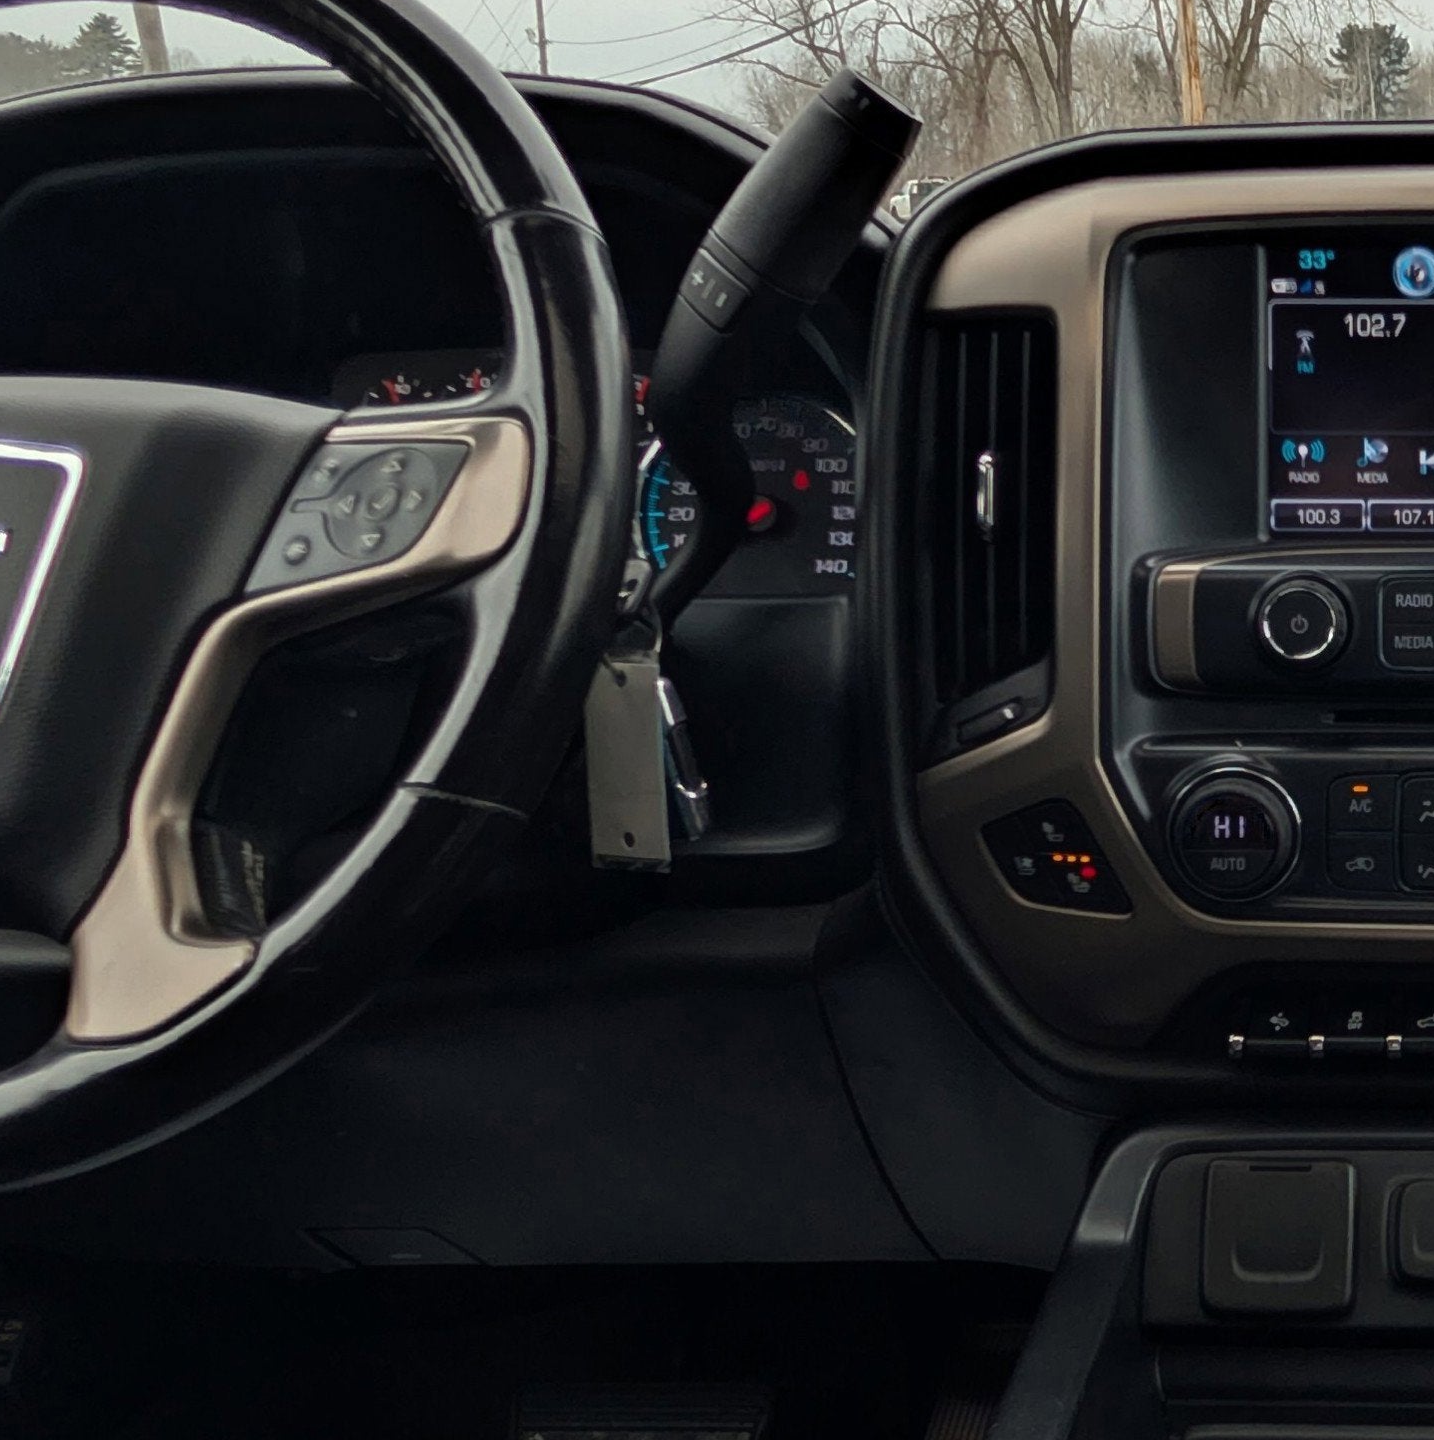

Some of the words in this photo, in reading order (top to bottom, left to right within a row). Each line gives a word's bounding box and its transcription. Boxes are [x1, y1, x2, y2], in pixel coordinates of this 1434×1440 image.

[1343, 313, 1407, 338] 102.7
[814, 458, 848, 473] 100
[1288, 472, 1320, 484] RADIO
[1356, 472, 1389, 484] MEDIA
[667, 506, 696, 522] 20
[1296, 509, 1341, 526] 100.3
[1393, 509, 1434, 526] 107.1
[815, 559, 848, 574] 140
[1395, 594, 1434, 608] RADIO
[1394, 635, 1434, 650] MEDIA
[1349, 799, 1373, 813] A/C
[1214, 815, 1246, 839] HI
[1210, 857, 1247, 871] AUTO
